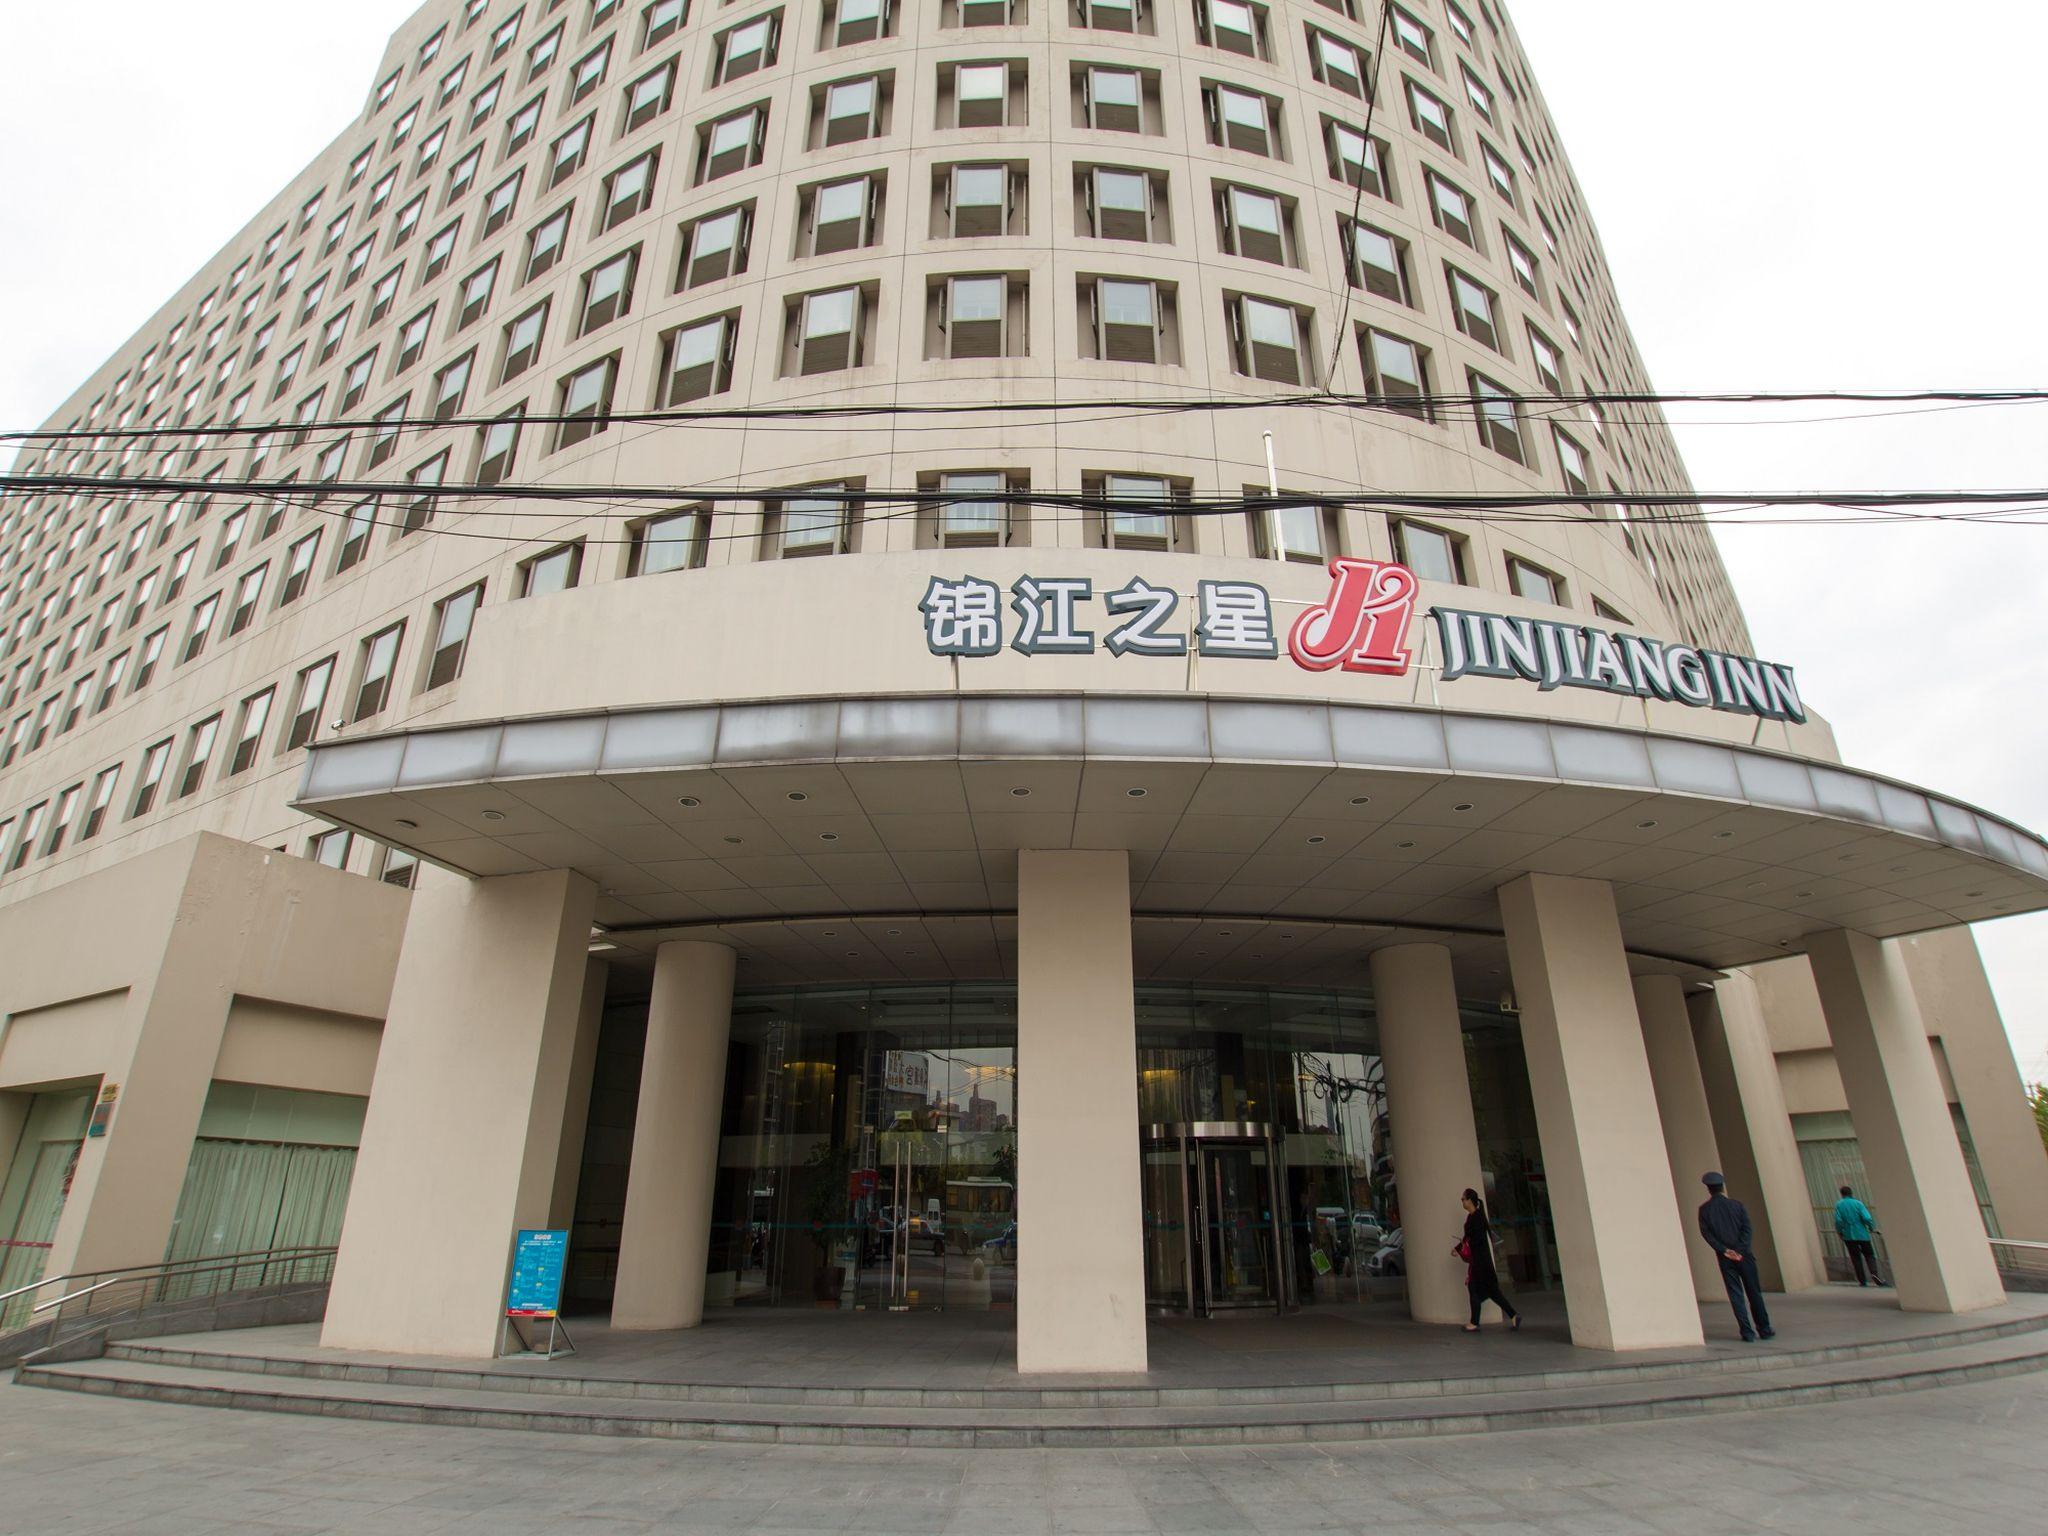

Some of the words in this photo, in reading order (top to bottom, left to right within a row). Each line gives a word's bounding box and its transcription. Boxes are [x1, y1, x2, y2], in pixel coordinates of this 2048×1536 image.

[919, 574, 1278, 660] 锦江之星
[1429, 606, 1712, 707] JINJIANG
[1698, 648, 1808, 724] INN
